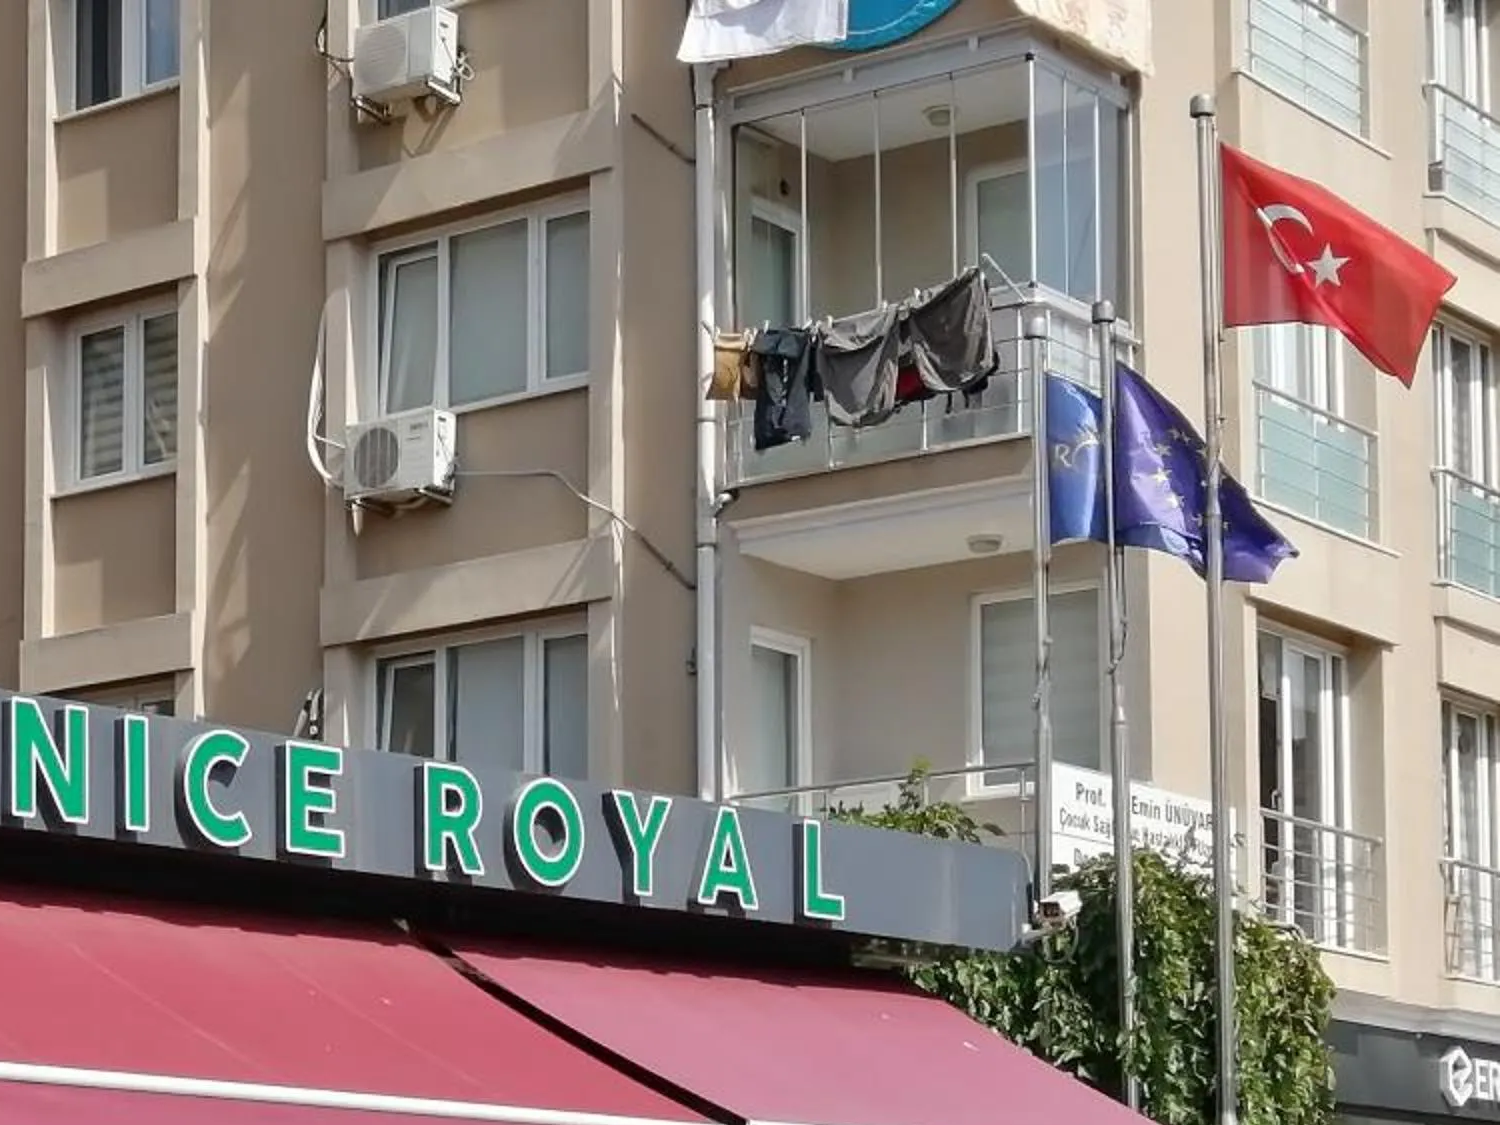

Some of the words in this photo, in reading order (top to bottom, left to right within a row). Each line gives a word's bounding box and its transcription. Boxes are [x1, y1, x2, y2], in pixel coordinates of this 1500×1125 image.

[8, 696, 346, 860] NICE
[420, 761, 847, 921] ROYAL
[1075, 781, 1107, 807] Prof.
[1131, 795, 1161, 820] Emin
